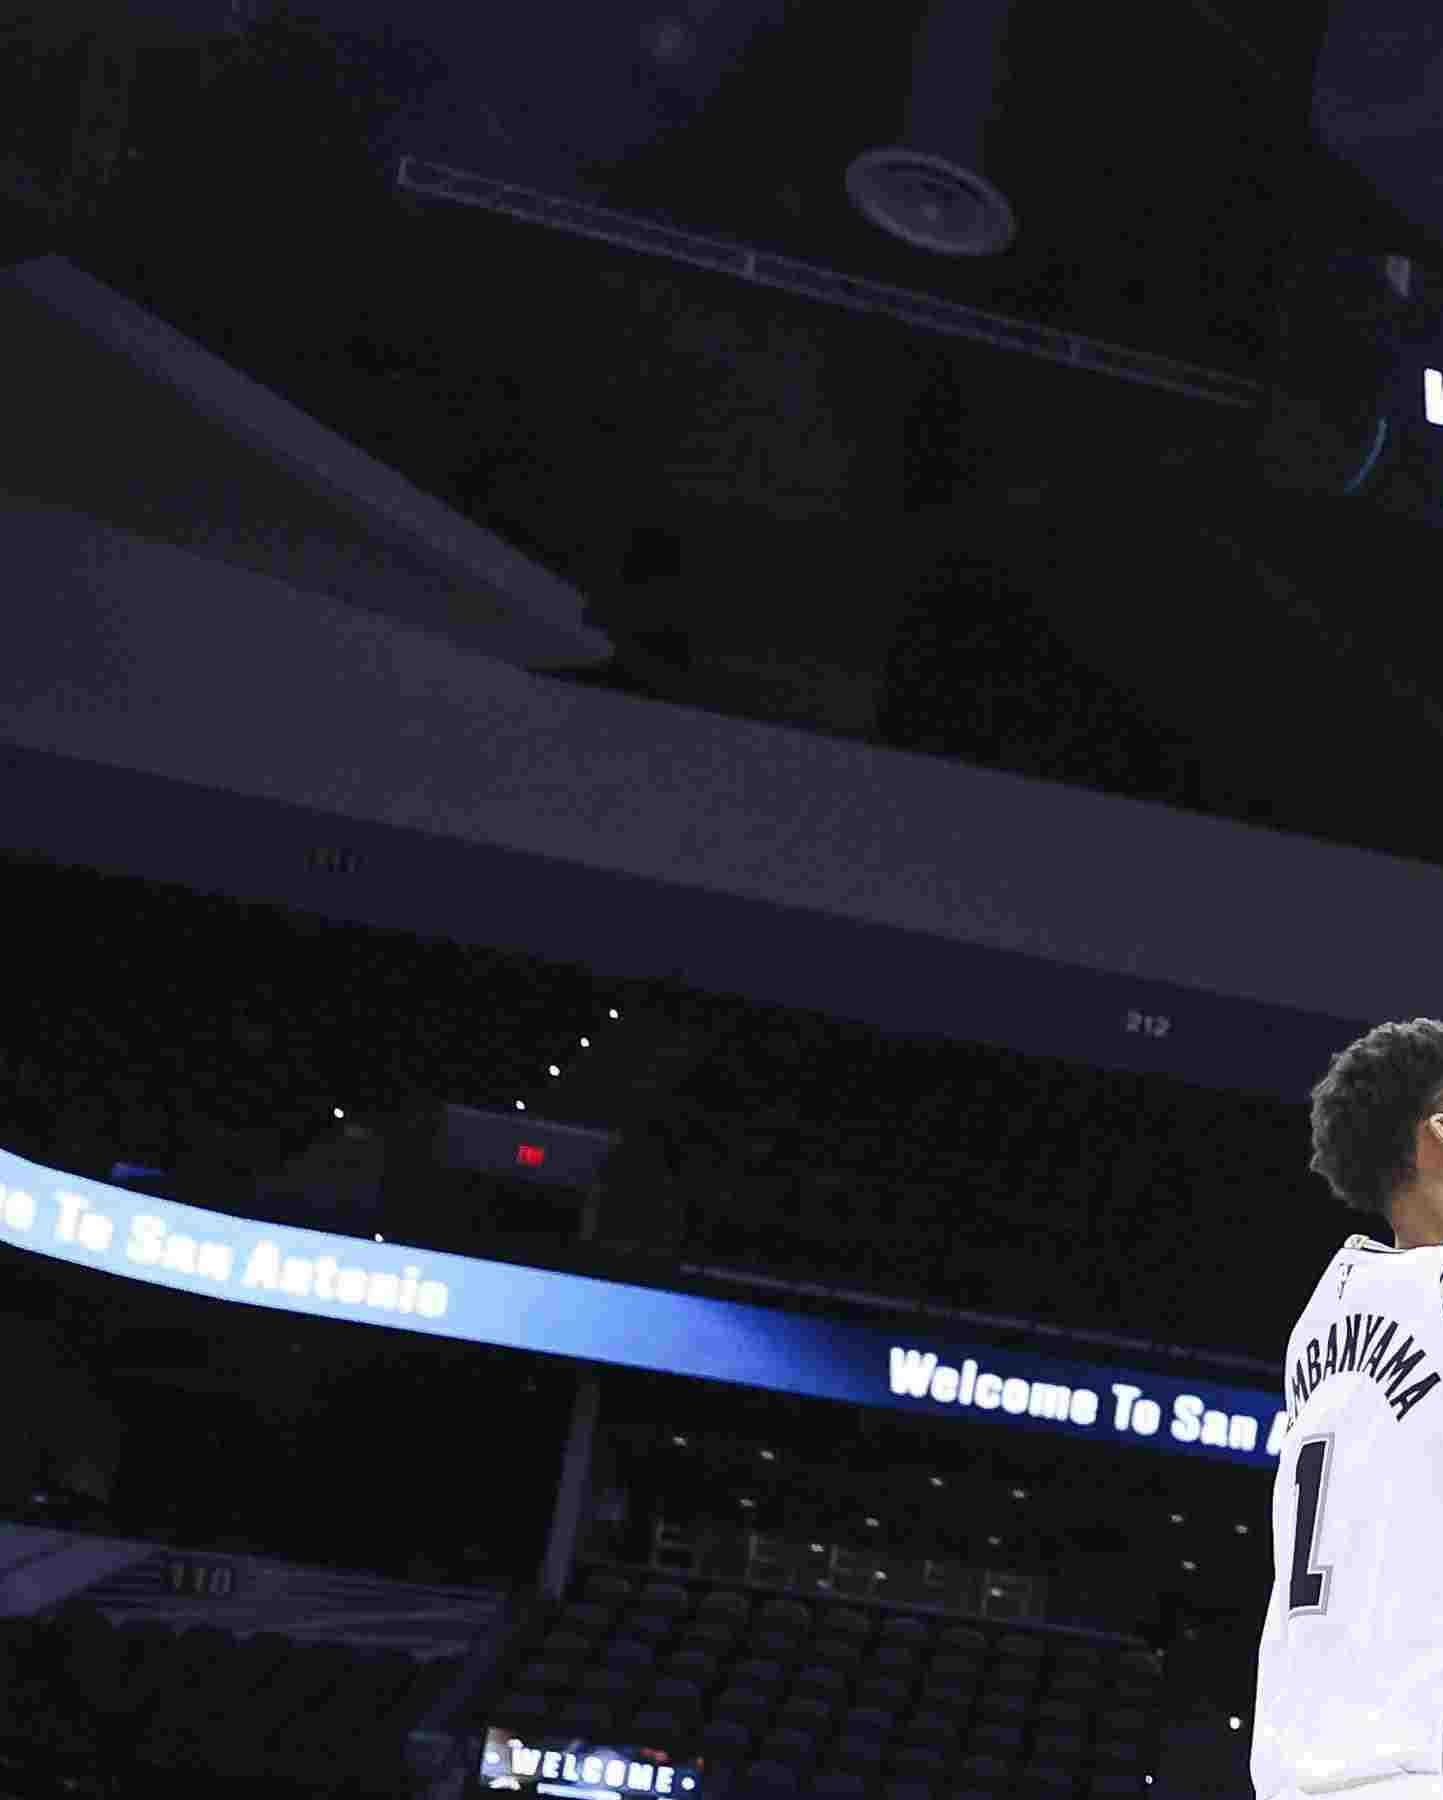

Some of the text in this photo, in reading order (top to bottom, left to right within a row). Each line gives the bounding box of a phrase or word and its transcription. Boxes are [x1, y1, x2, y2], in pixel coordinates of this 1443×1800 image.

[54, 1194, 113, 1251] To
[126, 1211, 231, 1282] San
[243, 1239, 448, 1318] Antonio
[889, 1346, 1097, 1426] Welcome
[1111, 1383, 1160, 1436] To
[1171, 1392, 1257, 1453] San
[1288, 1430, 1336, 1621] 1
[509, 1739, 674, 1795] WELCOME
